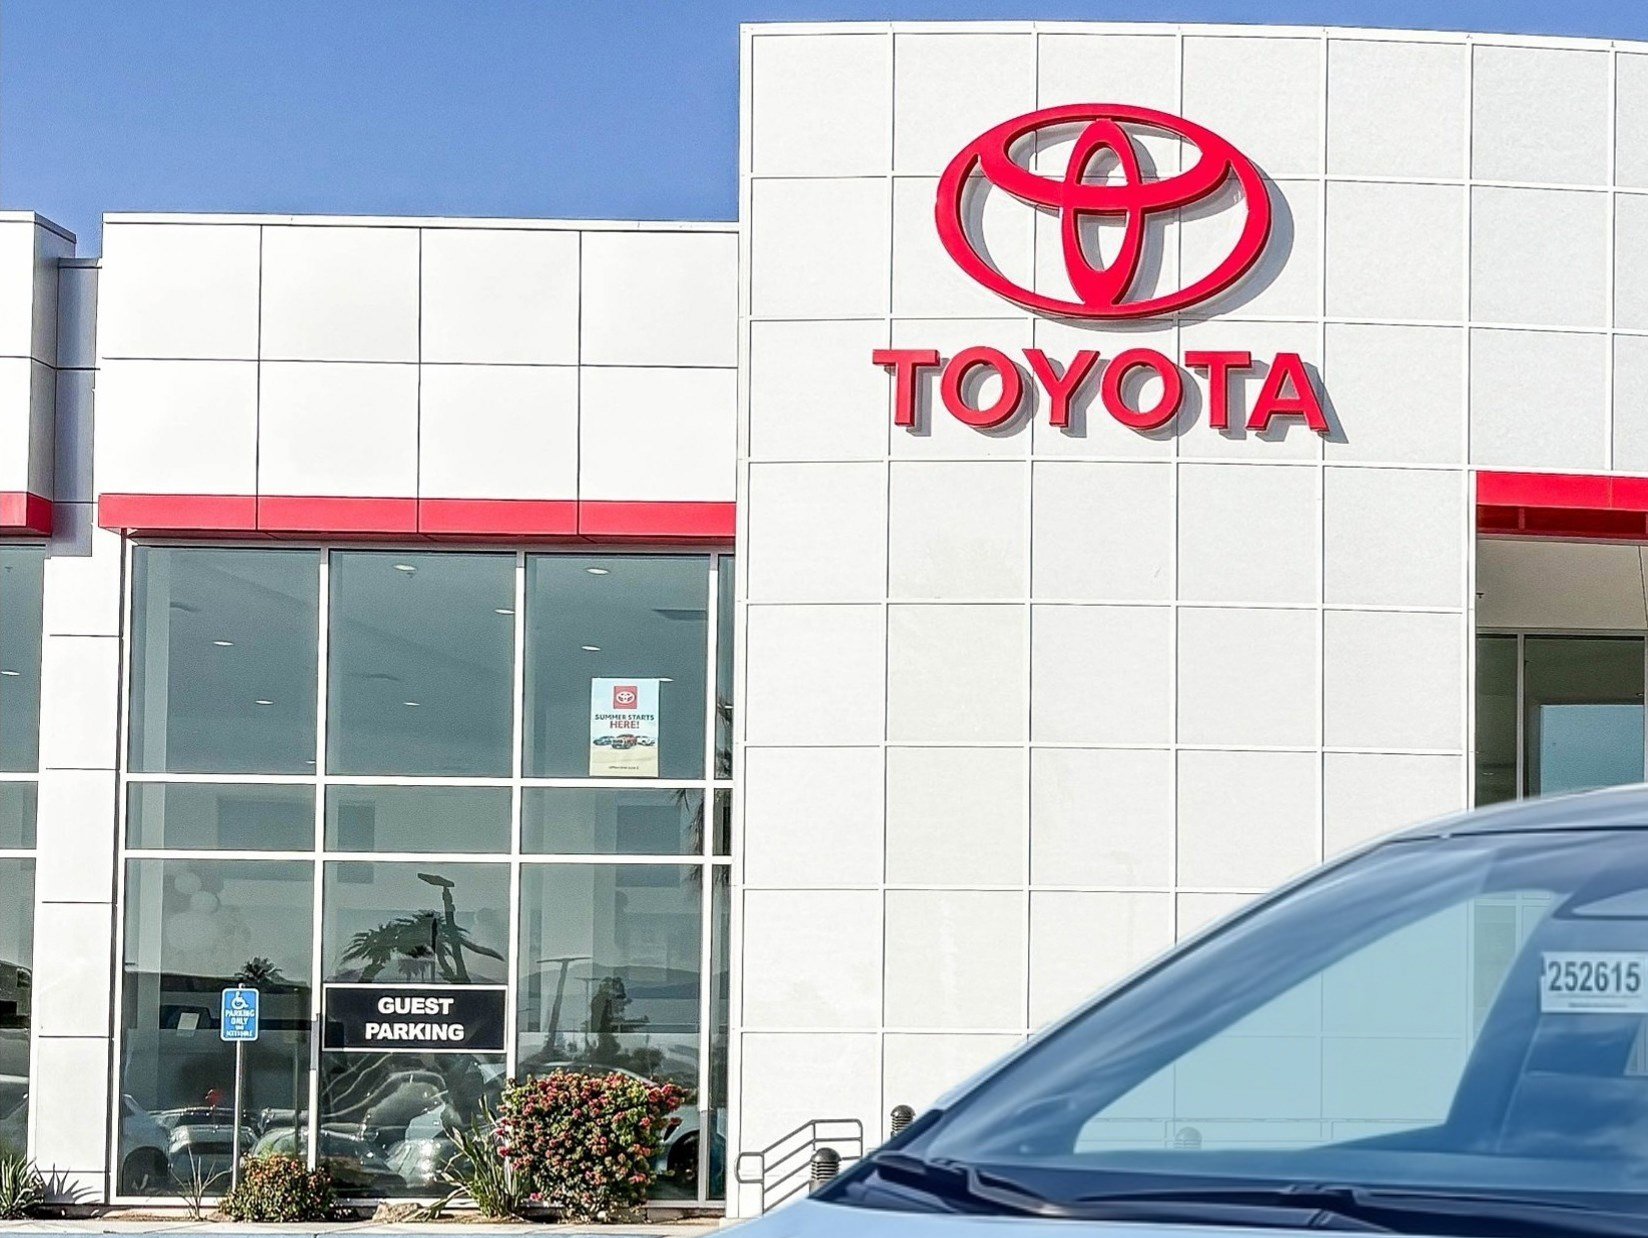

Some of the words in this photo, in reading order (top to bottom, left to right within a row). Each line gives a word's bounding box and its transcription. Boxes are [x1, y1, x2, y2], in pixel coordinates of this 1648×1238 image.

[873, 346, 1328, 432] TOYOTA
[609, 720, 640, 729] HERE!
[1548, 961, 1641, 992] 252615
[377, 997, 454, 1015] GUEST
[365, 1022, 465, 1041] PARKING
